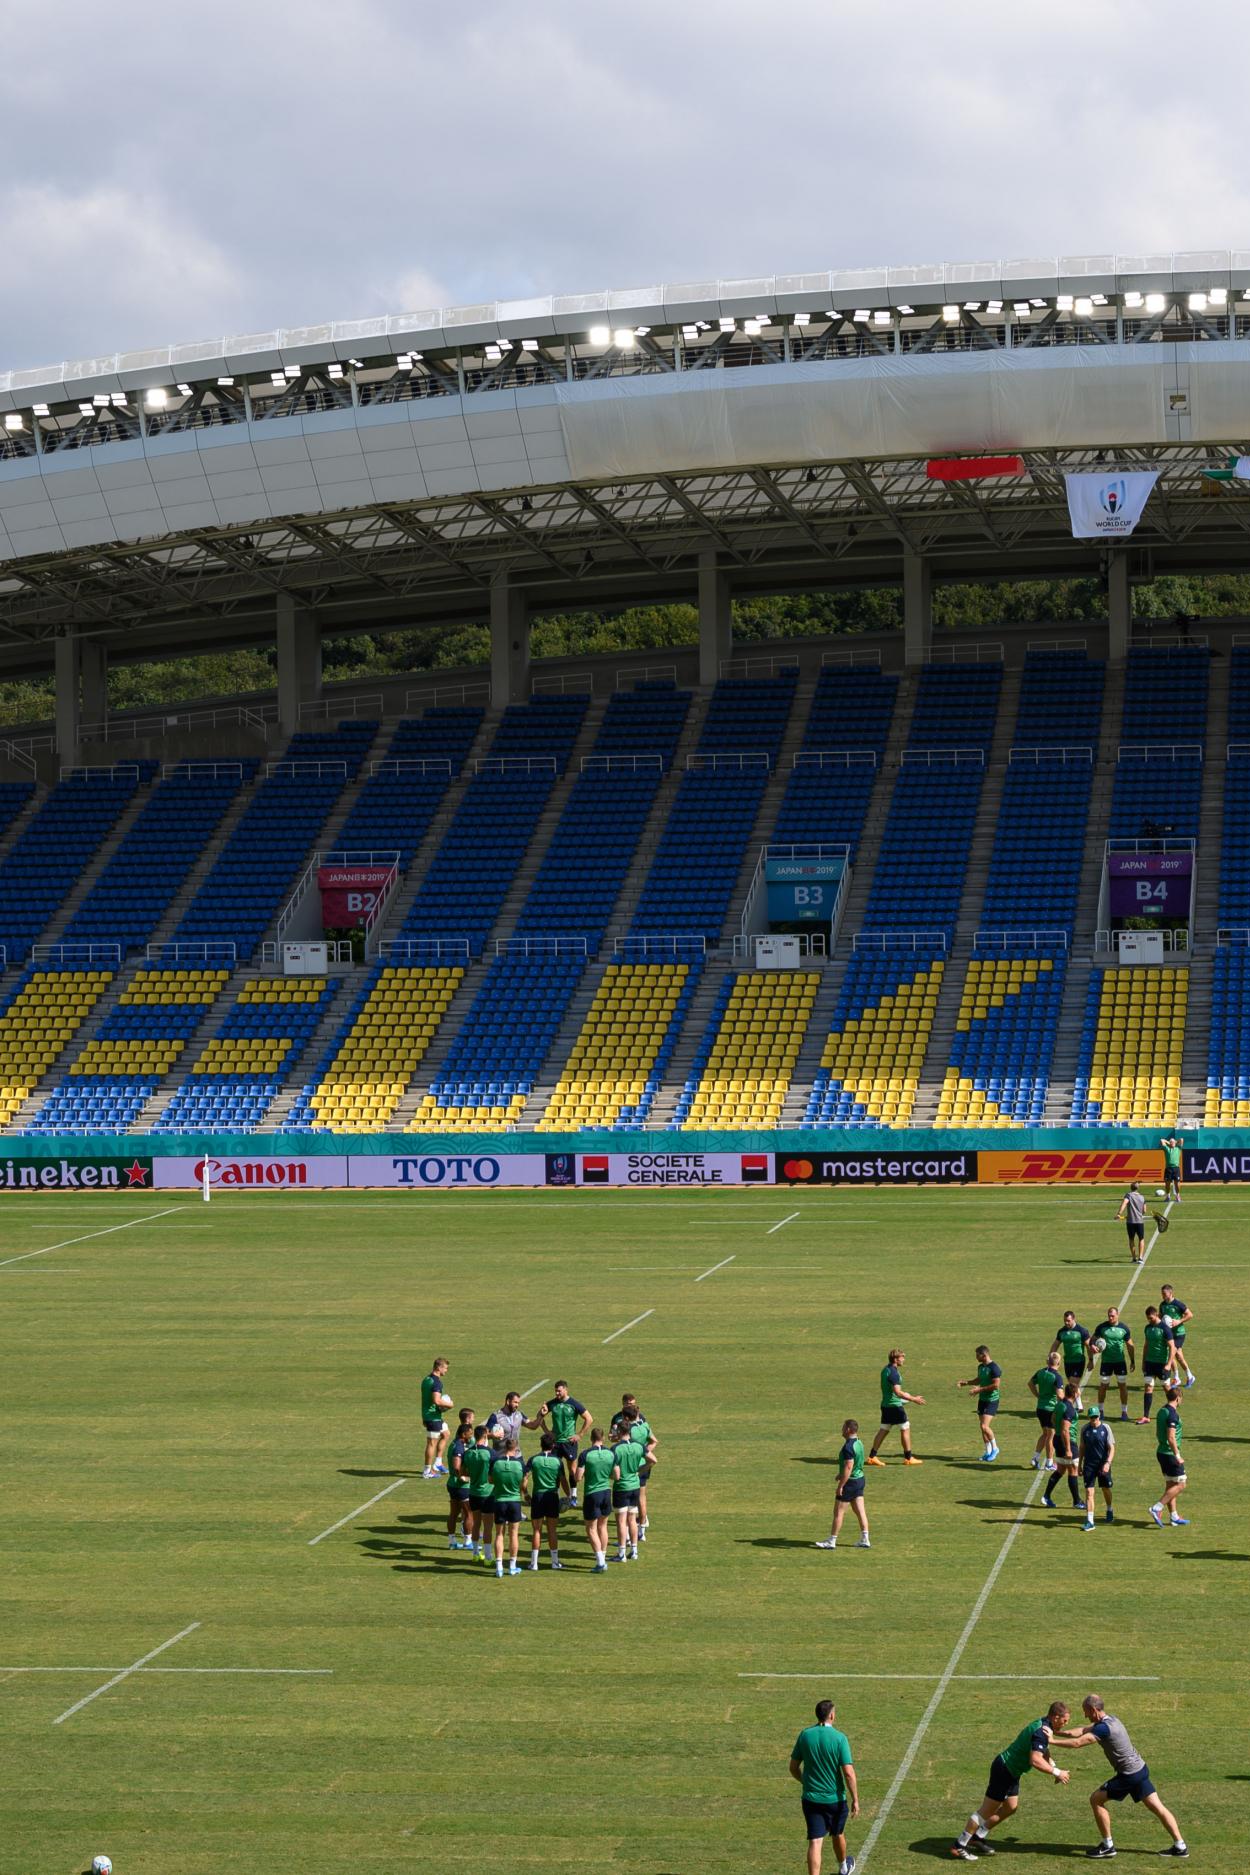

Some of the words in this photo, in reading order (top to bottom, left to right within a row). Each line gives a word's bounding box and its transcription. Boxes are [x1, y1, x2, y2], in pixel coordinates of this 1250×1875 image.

[794, 886, 823, 905] B3
[1135, 881, 1169, 900] B4
[347, 893, 377, 912] B2
[392, 1157, 500, 1183] TOTO
[627, 1155, 705, 1168] SOCIETE
[1018, 1154, 1140, 1178] DHL
[0, 1160, 120, 1186] ineken
[194, 1159, 307, 1185] Canon
[627, 1169, 723, 1183] GENERALE
